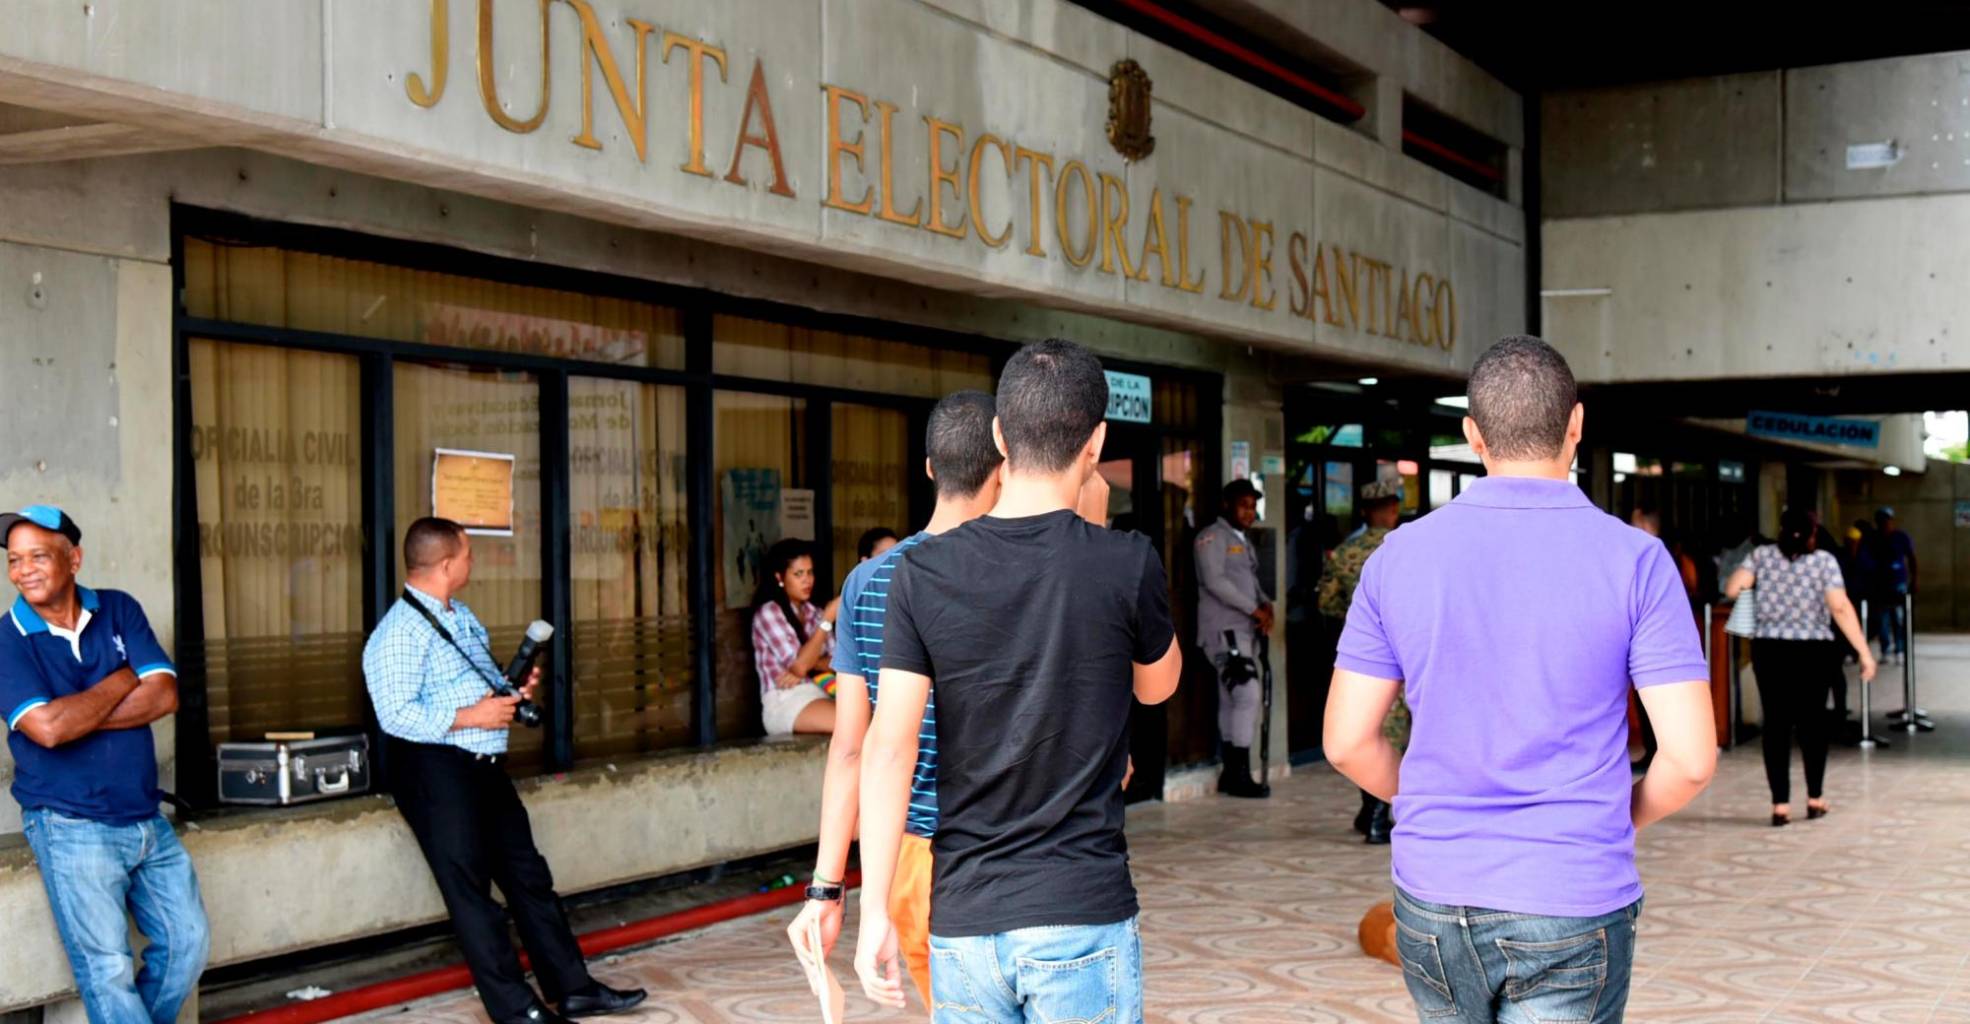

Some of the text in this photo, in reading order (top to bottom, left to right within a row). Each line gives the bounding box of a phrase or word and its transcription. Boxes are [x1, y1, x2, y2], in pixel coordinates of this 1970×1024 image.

[405, 0, 1457, 352] JUNTA ELECTORAL DE SANTIAGO
[303, 430, 356, 465] CIVIL
[235, 474, 260, 511] de
[267, 475, 285, 510] la
